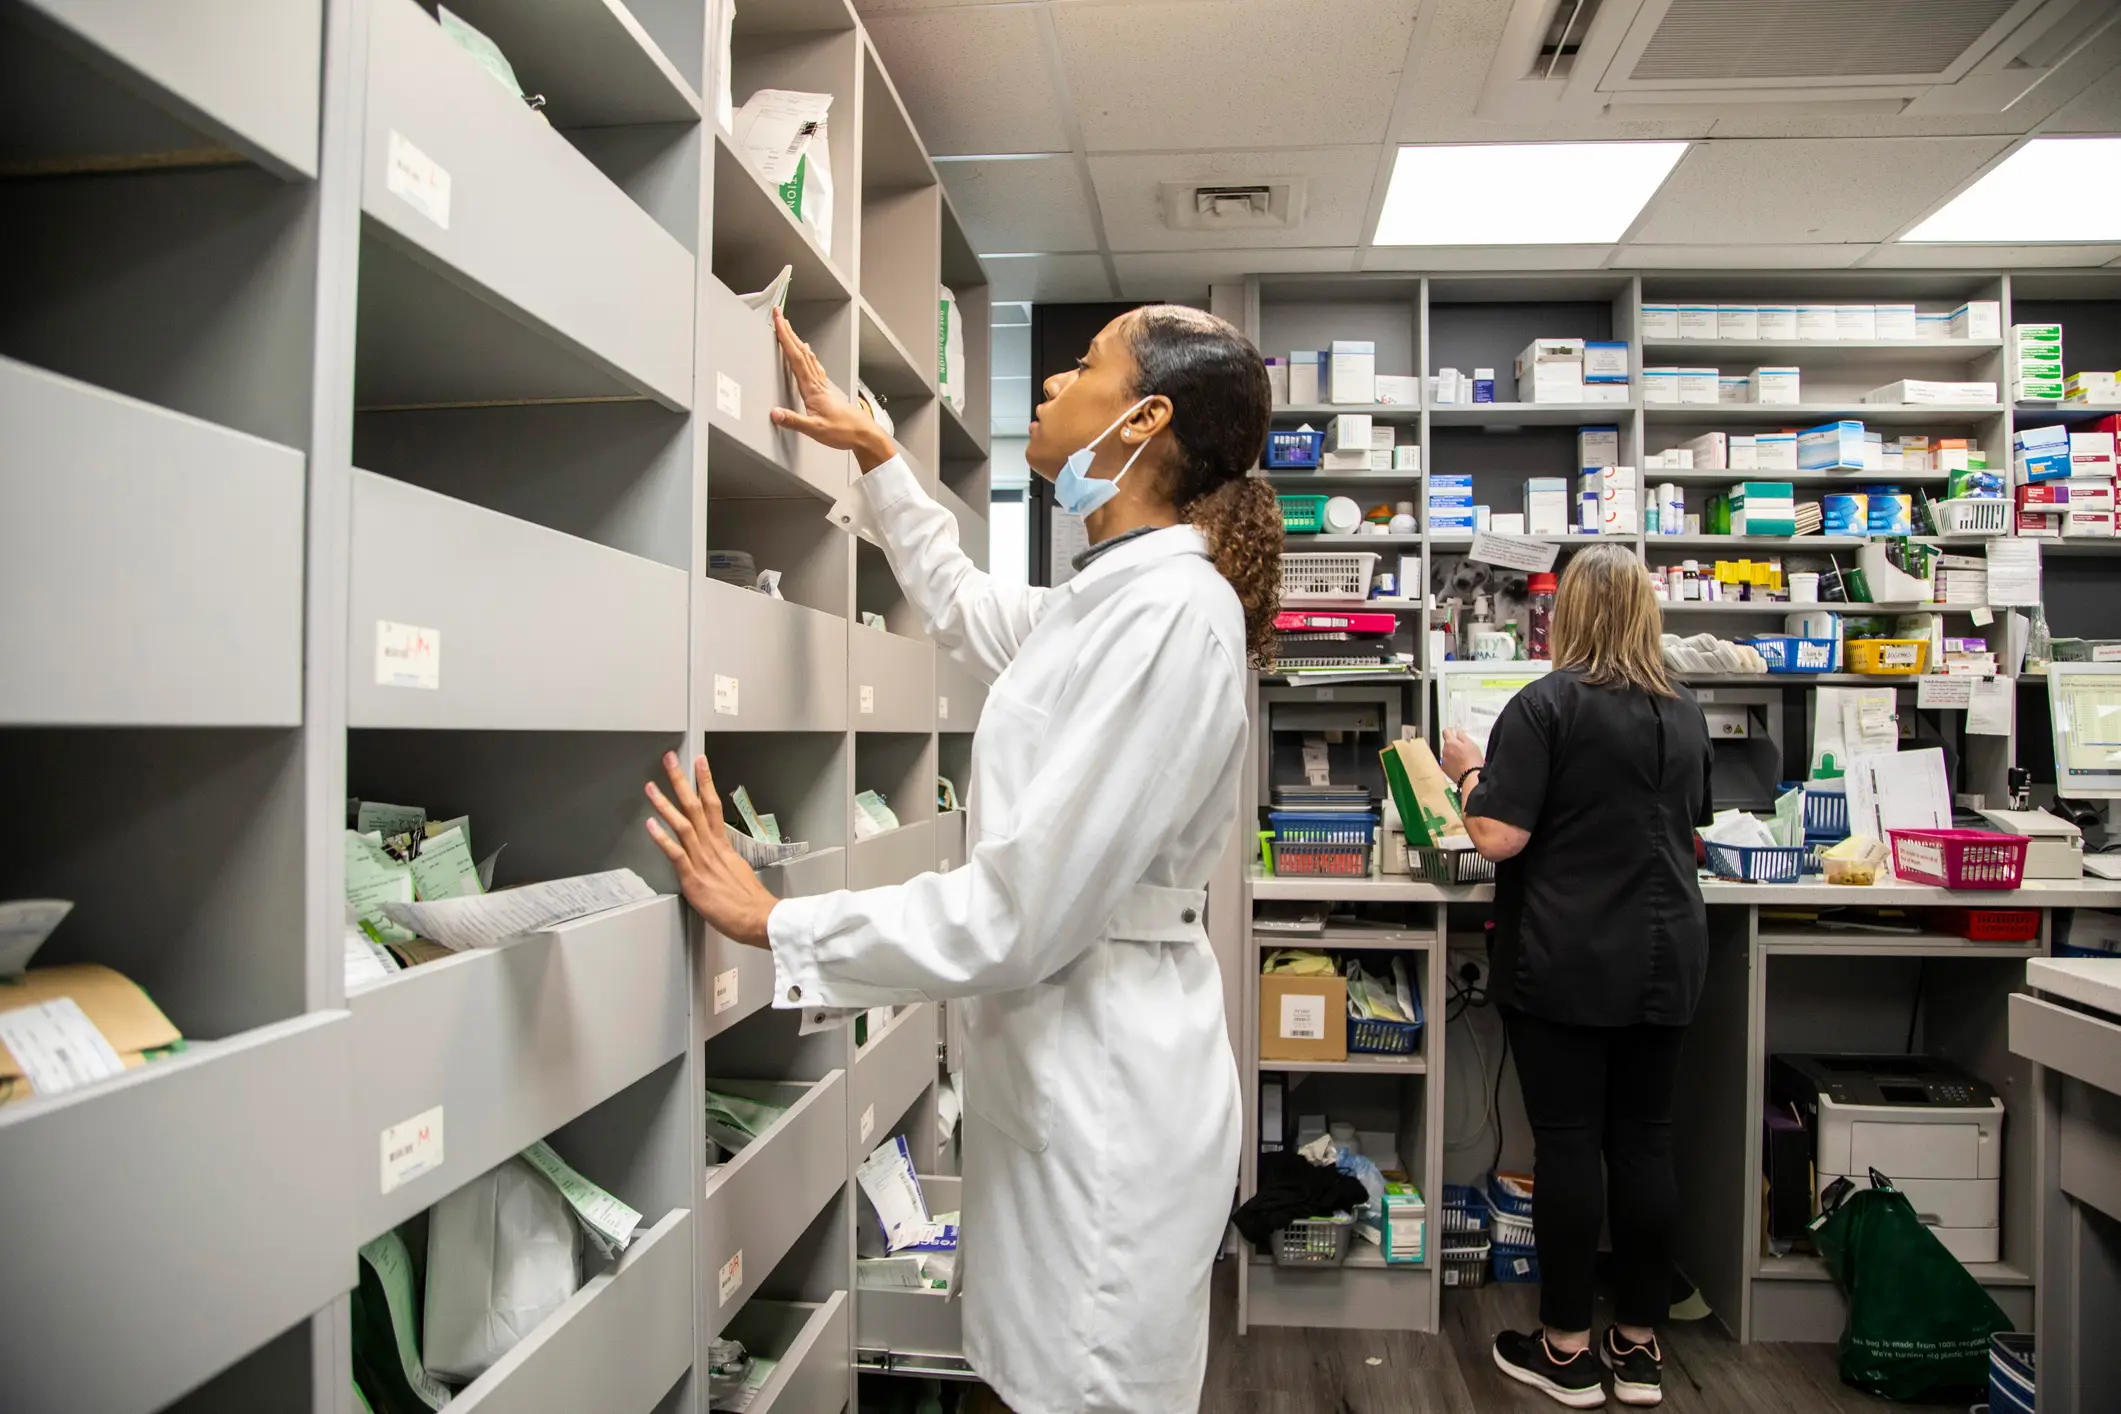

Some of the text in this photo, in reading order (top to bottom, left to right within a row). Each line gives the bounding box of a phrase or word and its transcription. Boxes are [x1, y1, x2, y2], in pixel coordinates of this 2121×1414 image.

[1865, 1339, 1880, 1348] bag
[1883, 1338, 1890, 1347] is
[1916, 1341, 1936, 1349] from
